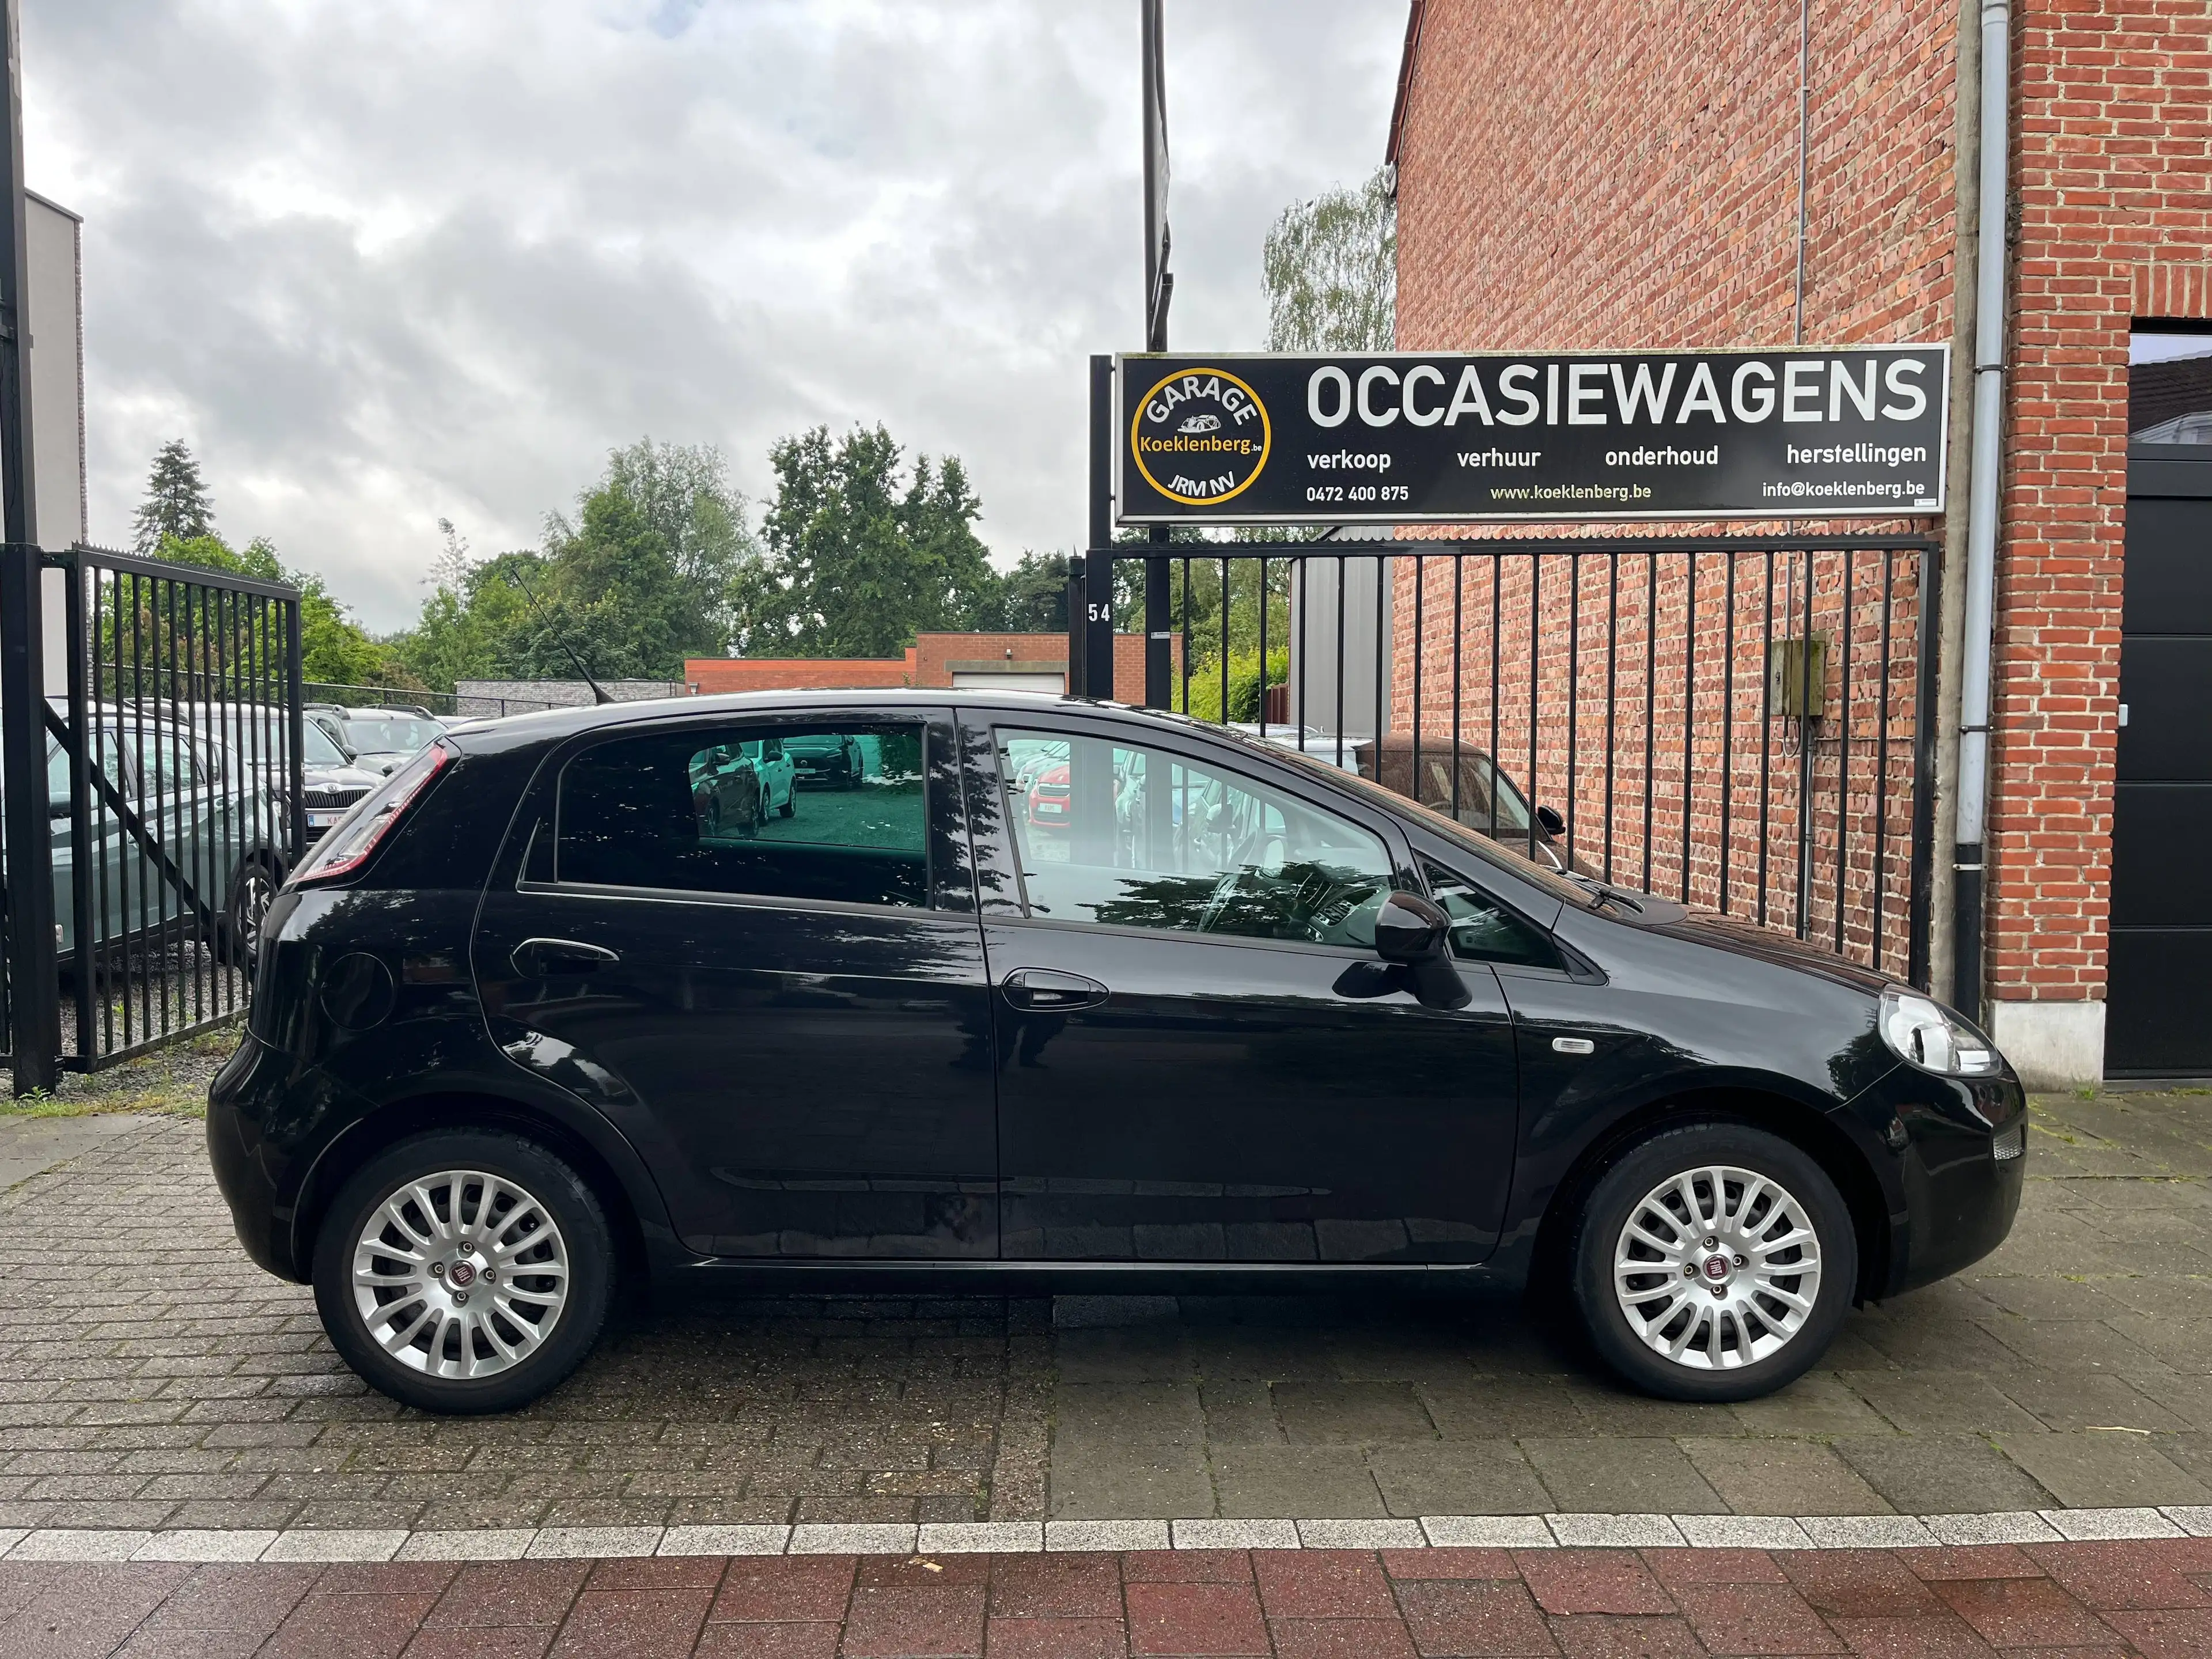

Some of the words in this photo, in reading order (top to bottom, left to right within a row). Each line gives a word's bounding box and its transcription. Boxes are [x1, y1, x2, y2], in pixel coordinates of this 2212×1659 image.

[1146, 376, 1257, 423] GARAGE
[1308, 359, 1927, 427] OCCASIEWAGENS
[1307, 449, 1391, 473] verkoop
[1457, 448, 1541, 467] verhuur
[1605, 445, 1718, 466] onderhoud
[1787, 442, 1926, 467] herstellingen
[1168, 475, 1206, 497] JRM
[1210, 471, 1234, 495] NV
[1490, 483, 1652, 502] www.koeklenberg.be
[1763, 480, 1925, 498] info@koeklenberg.be
[1306, 486, 1343, 502] 0472
[1348, 486, 1376, 501] 400
[1381, 486, 1409, 501] 875
[1088, 603, 1110, 622] 54
[454, 1266, 471, 1282] FIAT
[1709, 1260, 1722, 1275] FIAT
